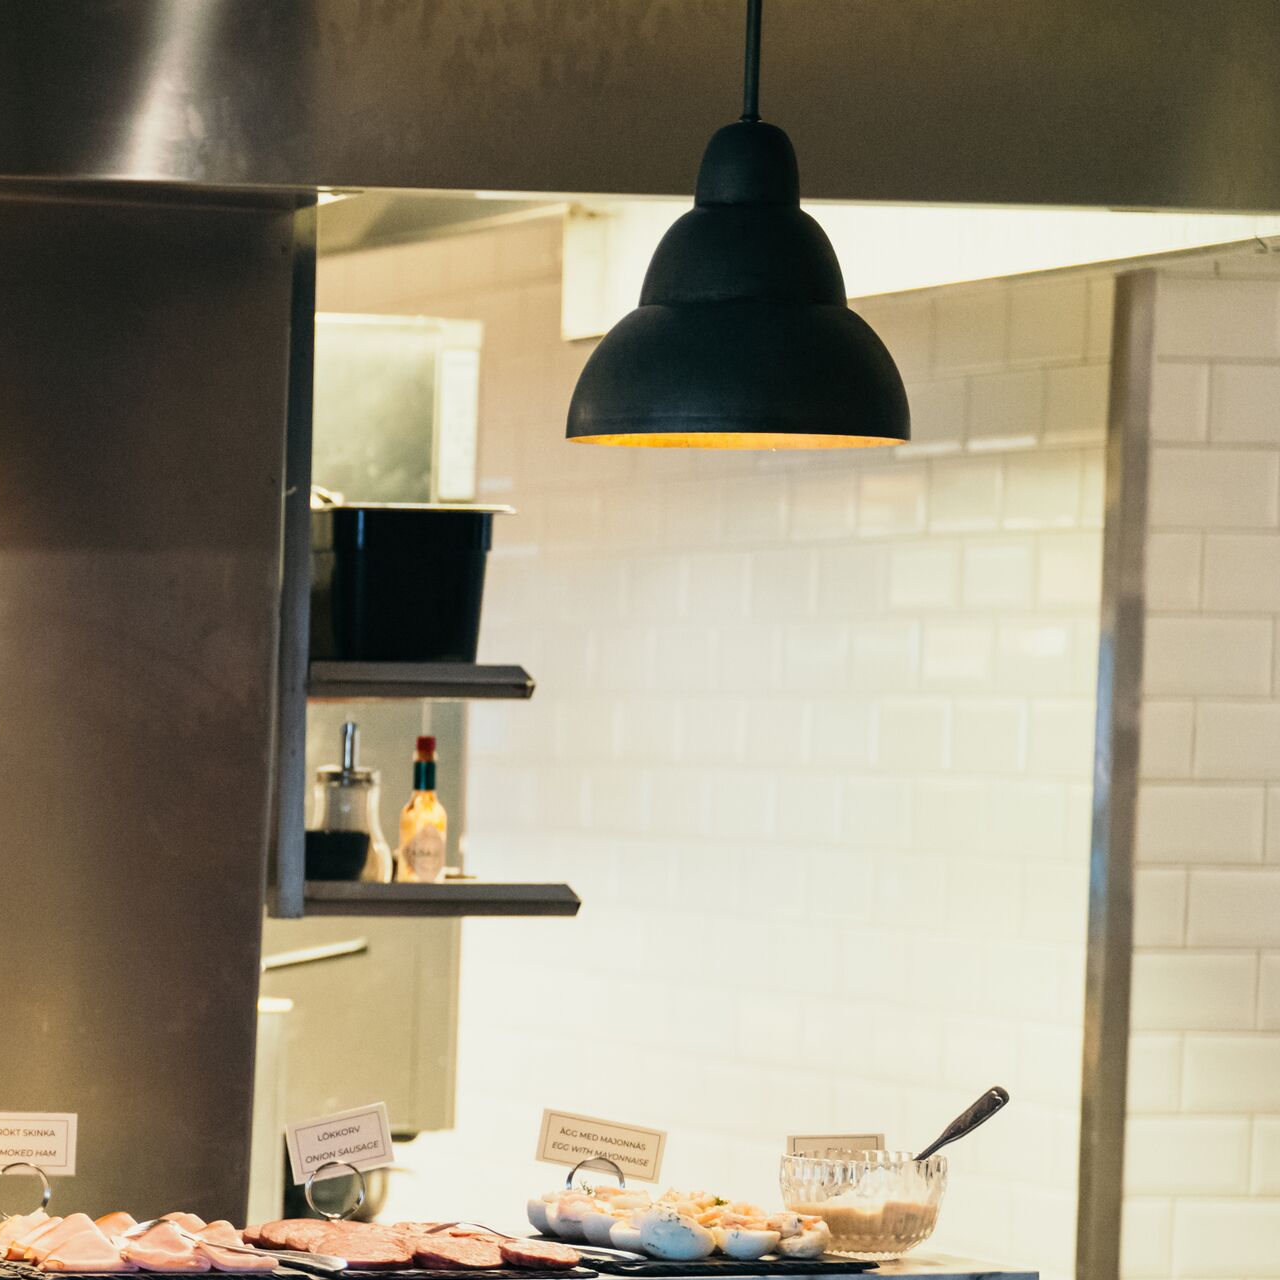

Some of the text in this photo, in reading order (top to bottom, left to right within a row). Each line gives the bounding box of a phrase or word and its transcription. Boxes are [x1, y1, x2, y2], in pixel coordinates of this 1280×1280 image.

[23, 1129, 56, 1137] SKINKA
[580, 1132, 599, 1142] MED
[305, 1140, 379, 1164] ONION SAUSAGE
[552, 1141, 650, 1167] EGG WITH MAYONNAISE
